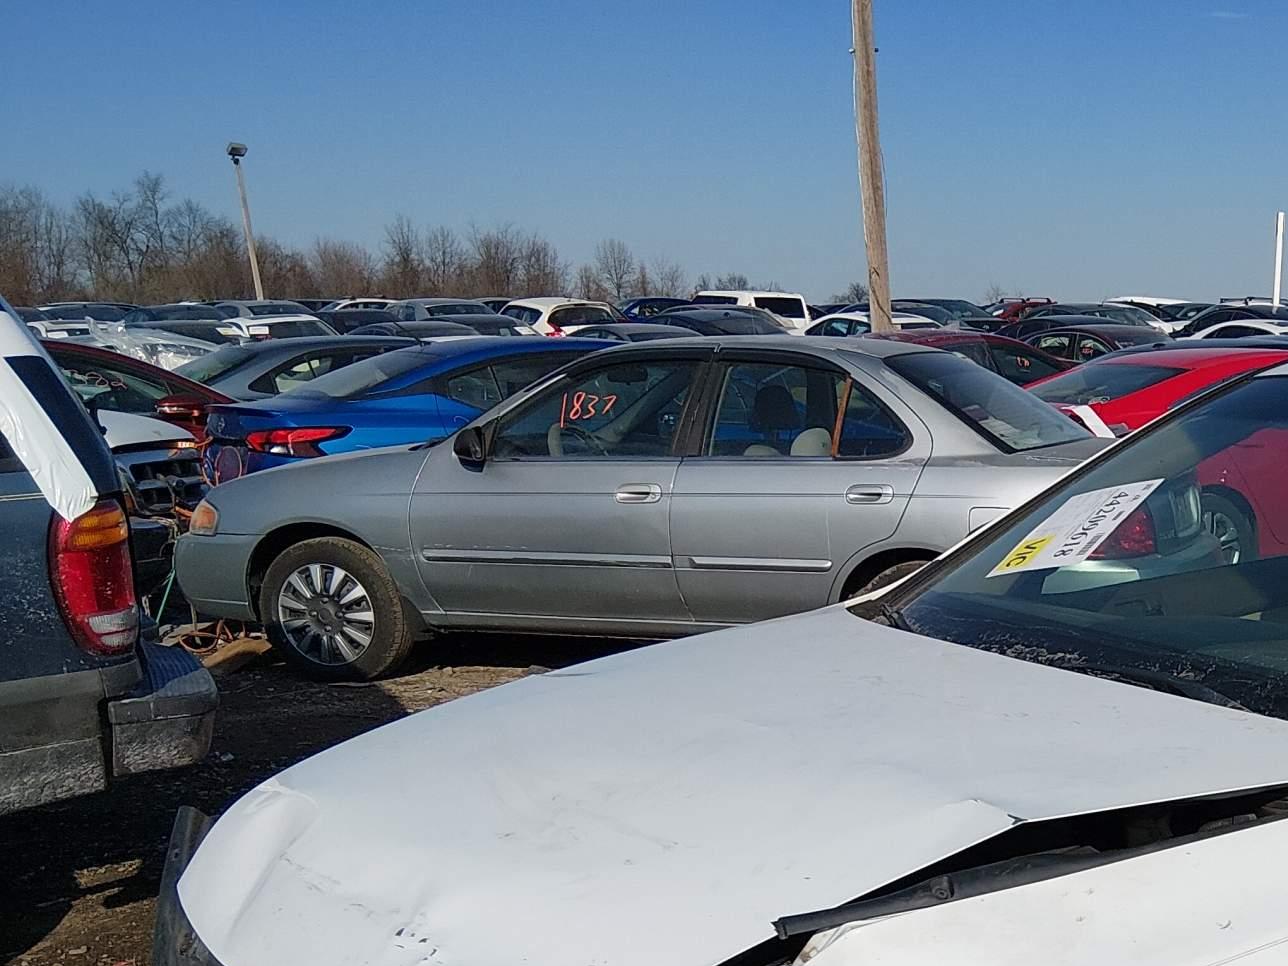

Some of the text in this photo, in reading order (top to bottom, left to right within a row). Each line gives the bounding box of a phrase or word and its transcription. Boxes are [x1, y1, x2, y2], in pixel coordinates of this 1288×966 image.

[560, 391, 617, 428] 1837
[1053, 490, 1129, 558] 44209618
[1006, 538, 1048, 567] VIC
